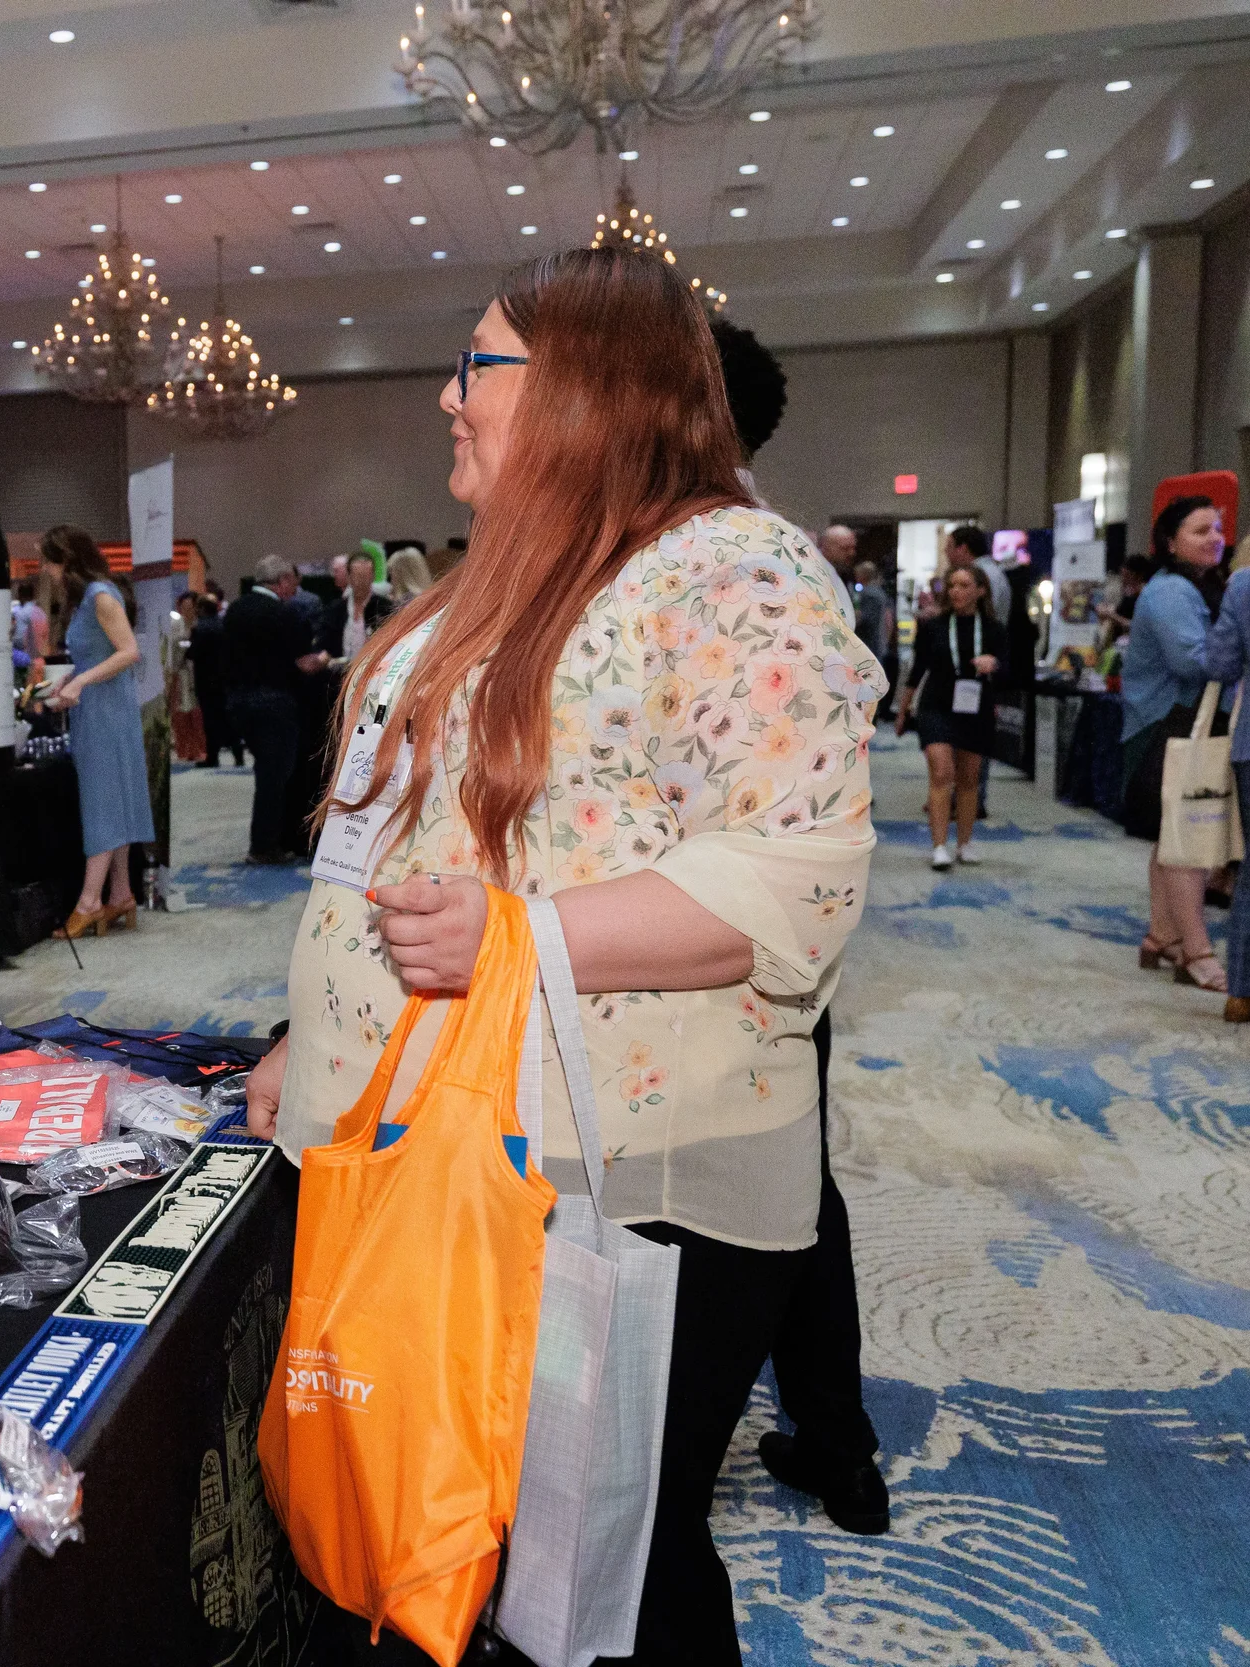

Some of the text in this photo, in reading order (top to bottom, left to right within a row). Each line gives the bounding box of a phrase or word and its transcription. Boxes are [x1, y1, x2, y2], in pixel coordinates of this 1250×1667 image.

[384, 647, 414, 687] Littler
[345, 812, 369, 825] Jennie
[344, 825, 363, 839] Dilley
[344, 842, 354, 850] GM
[338, 861, 350, 870] Quail
[350, 865, 368, 876] springs
